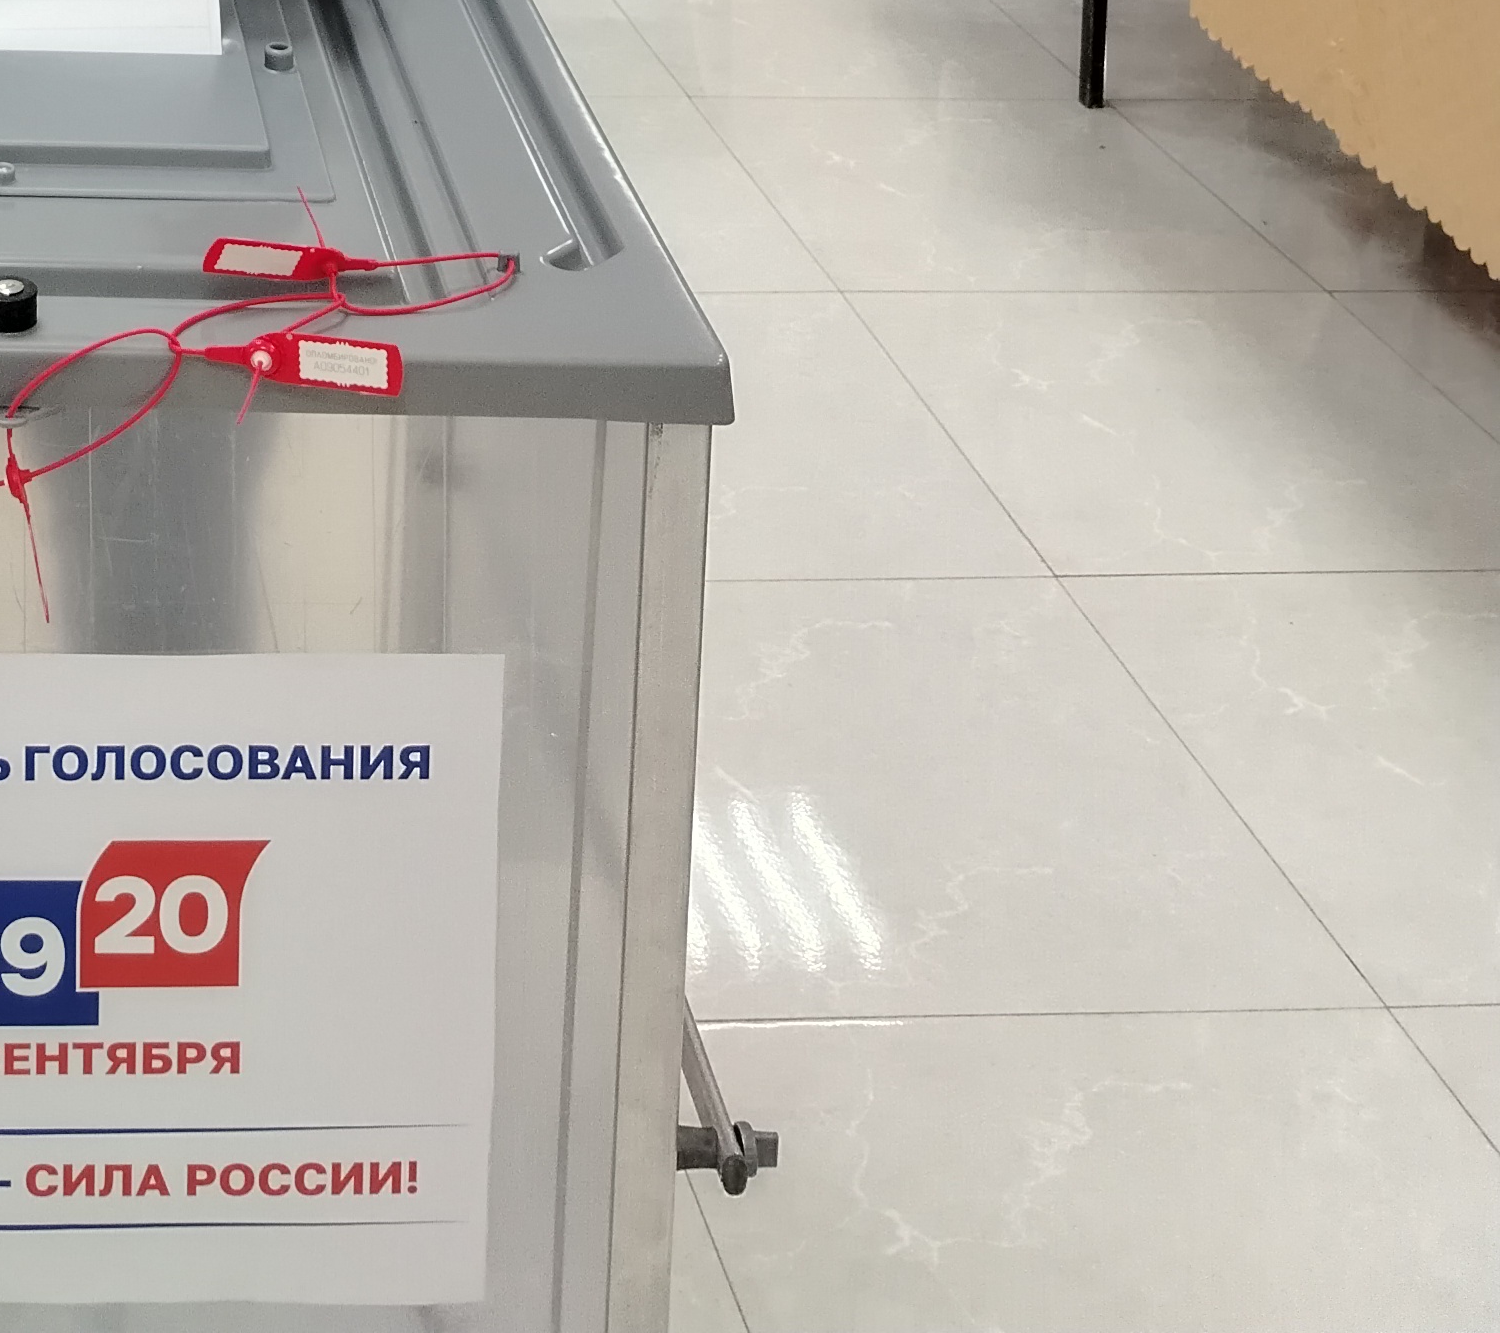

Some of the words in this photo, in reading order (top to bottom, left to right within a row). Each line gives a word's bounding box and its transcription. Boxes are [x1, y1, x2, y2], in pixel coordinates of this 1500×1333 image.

[25, 745, 431, 783] ГОЛОСОВАНИЯ
[94, 874, 229, 955] 20
[26, 1165, 170, 1198] СИЛА
[188, 1162, 418, 1197] РОССИИ!
